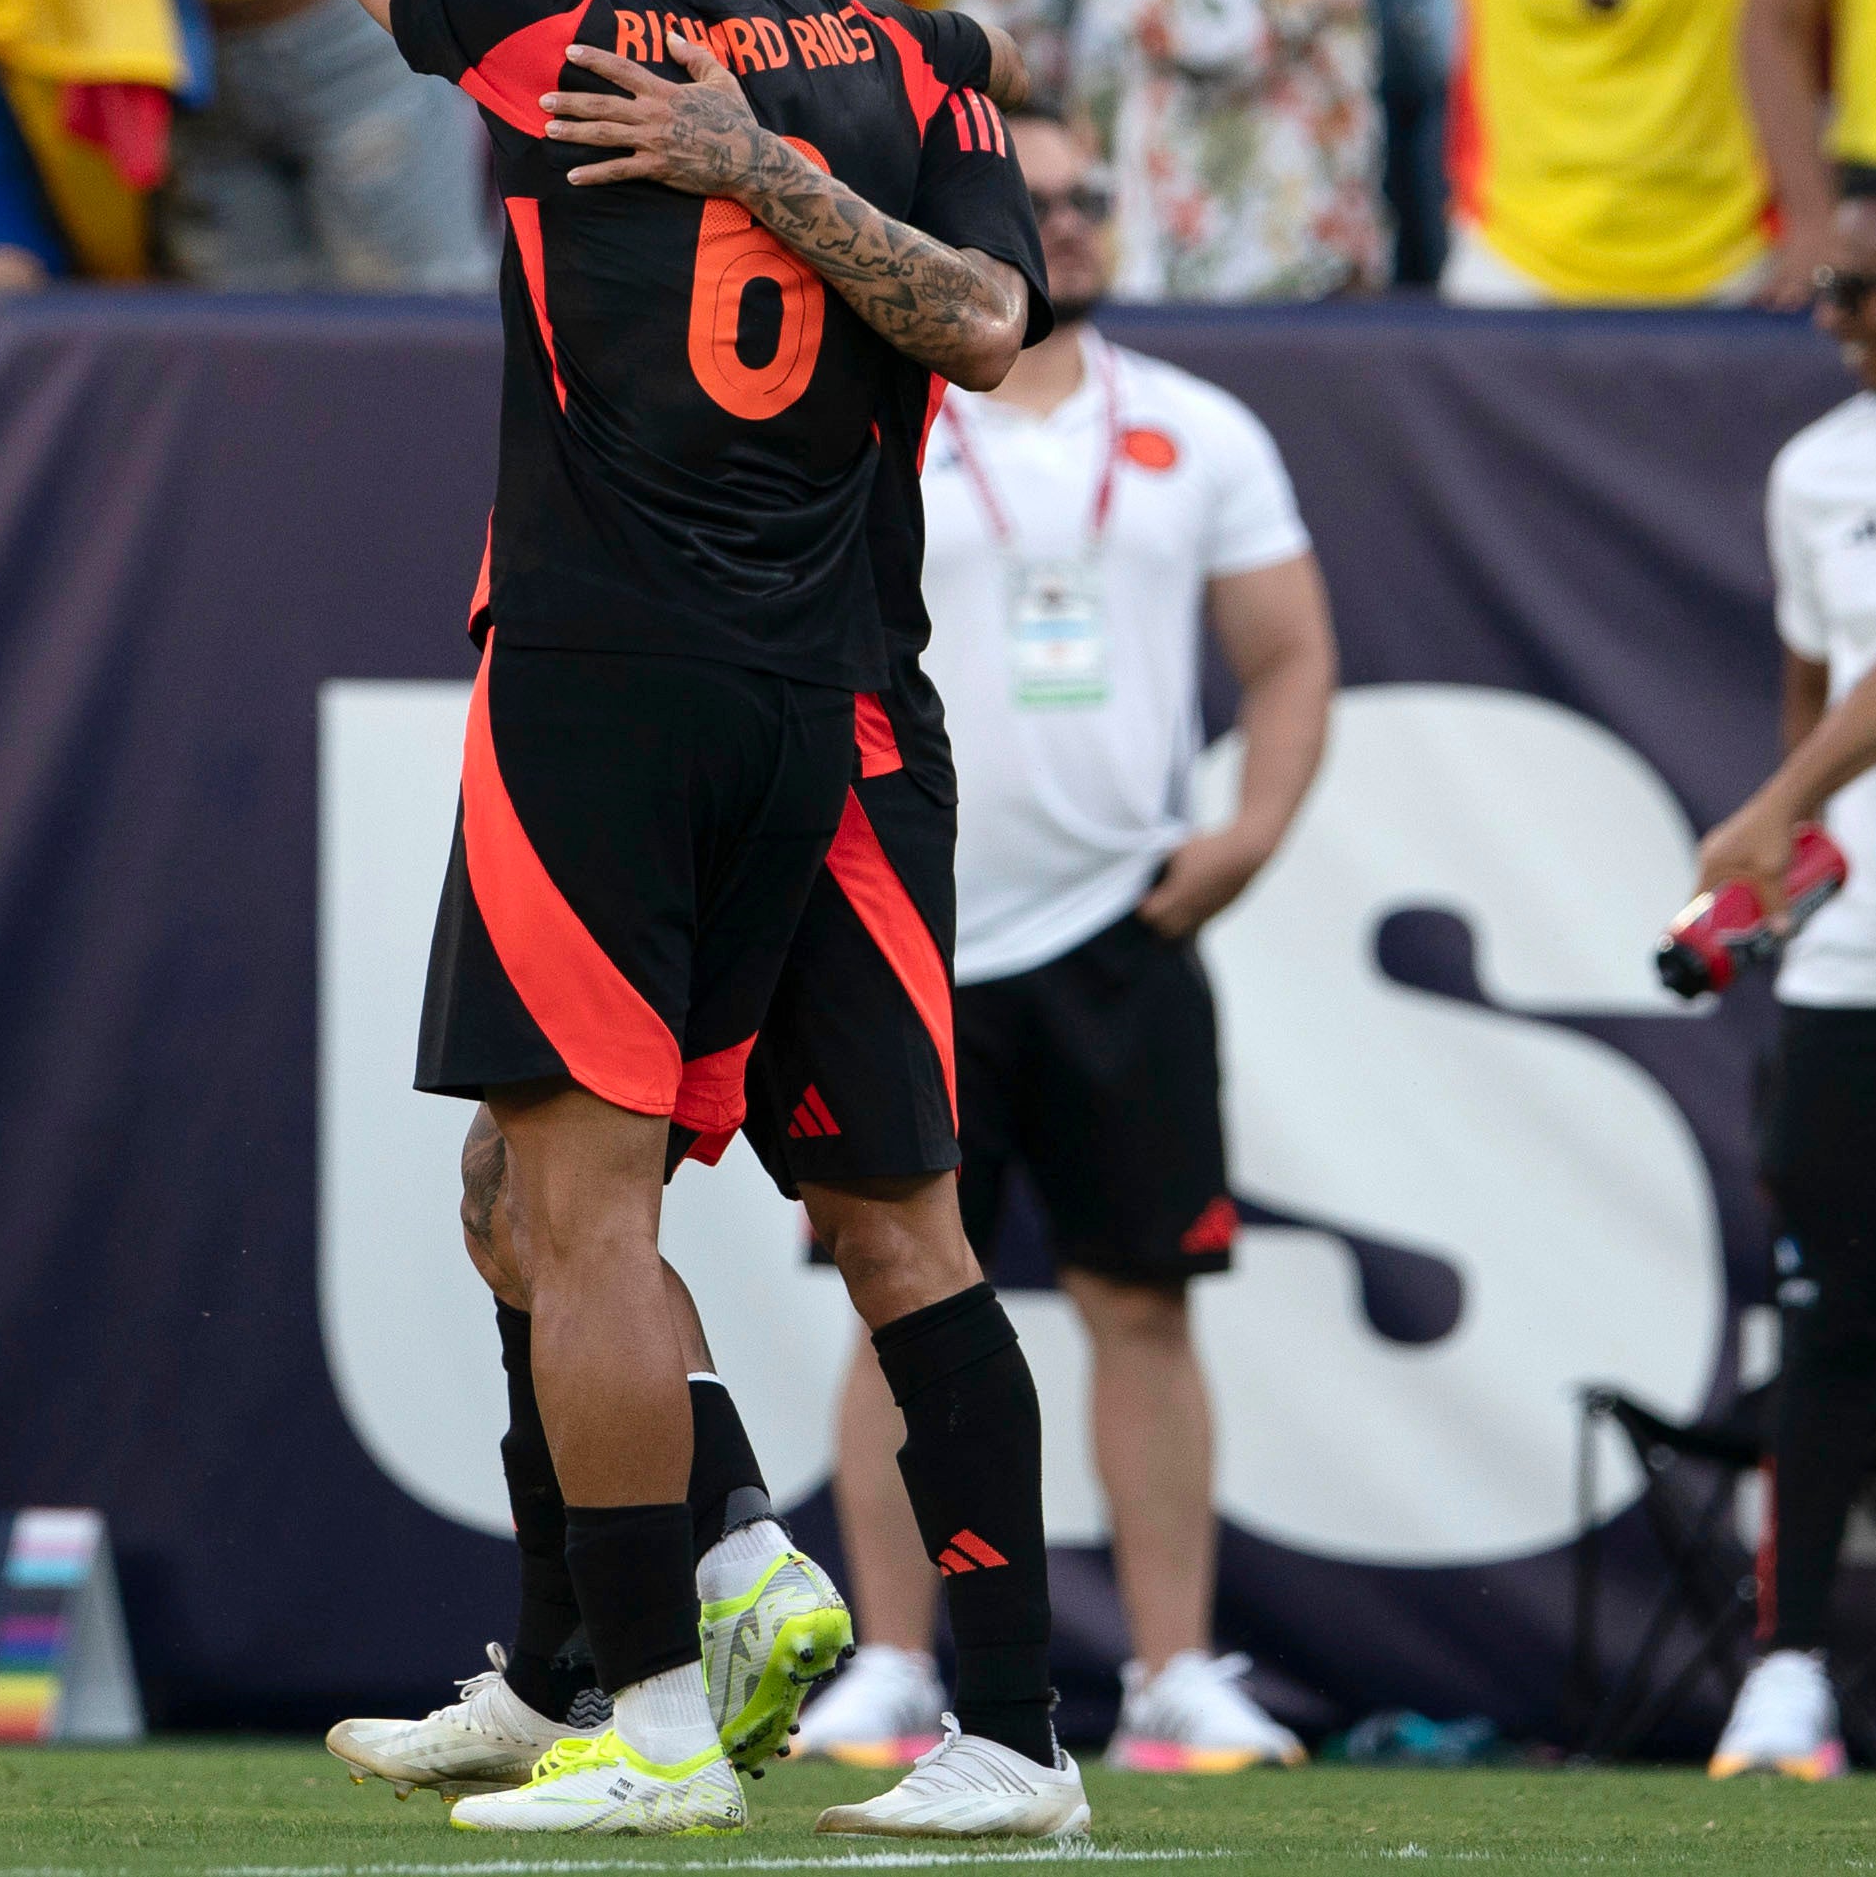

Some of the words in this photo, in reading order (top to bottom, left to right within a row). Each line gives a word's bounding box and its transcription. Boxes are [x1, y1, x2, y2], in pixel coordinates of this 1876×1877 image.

[787, 5, 876, 71] RIOS
[687, 135, 832, 421] 6
[725, 1806, 740, 1818] 27
